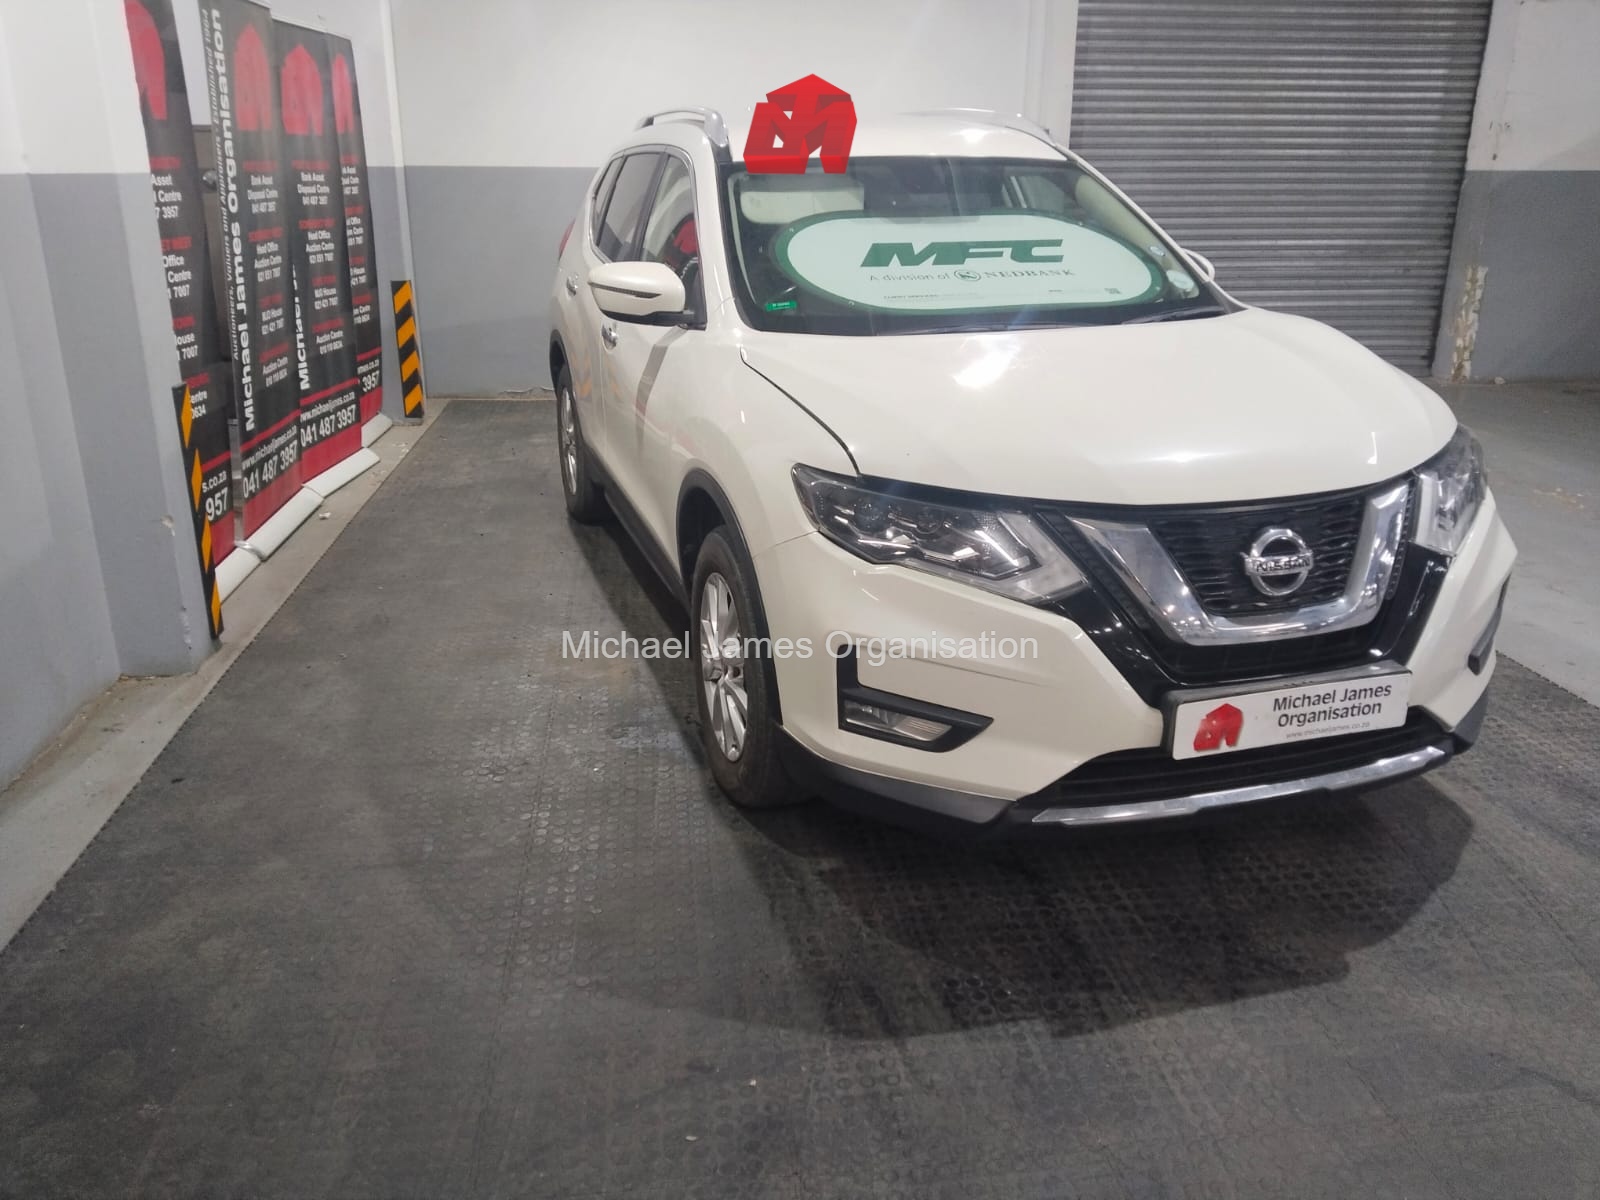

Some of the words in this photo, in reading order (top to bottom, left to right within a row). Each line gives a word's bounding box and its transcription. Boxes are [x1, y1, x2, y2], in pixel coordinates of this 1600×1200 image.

[211, 8, 239, 214] Organisation
[224, 236, 234, 282] Valuers
[860, 239, 1064, 267] MFC
[168, 270, 192, 283] Centre
[230, 221, 248, 316] James
[882, 273, 934, 281] division
[937, 272, 950, 280] of
[984, 268, 1075, 278] NEDBANK
[237, 323, 256, 432] Michael
[362, 370, 380, 392] 3957
[190, 390, 207, 404] entre
[300, 423, 318, 448] 041
[319, 413, 336, 438] 487
[336, 404, 356, 430] 3957
[242, 468, 260, 498] 041
[262, 454, 278, 482] 487
[280, 439, 298, 470] 3957
[1273, 689, 1336, 712] Michael
[1340, 684, 1392, 702] James
[1278, 702, 1382, 728] Organisation
